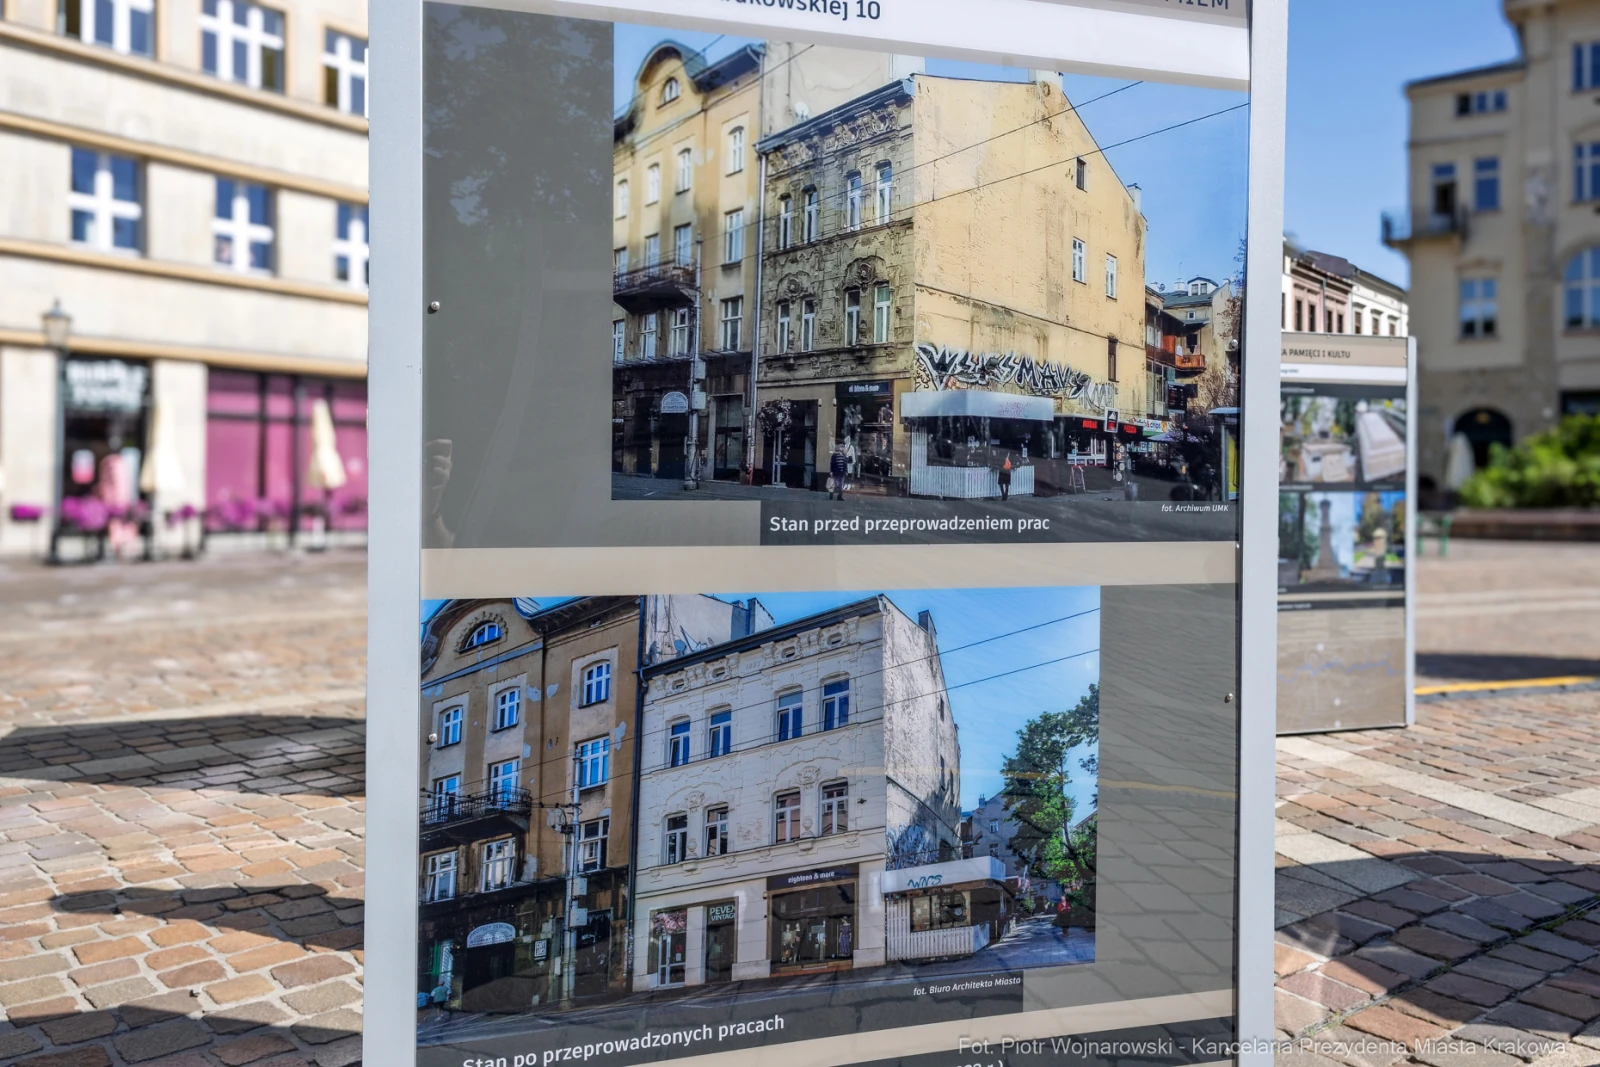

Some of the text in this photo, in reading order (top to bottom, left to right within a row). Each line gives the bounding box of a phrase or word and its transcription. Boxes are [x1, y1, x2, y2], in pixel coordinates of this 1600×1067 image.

[856, 0, 881, 20] 10
[1289, 348, 1320, 359] PAMIĘCI
[1328, 350, 1351, 359] KULTU
[1161, 503, 1229, 512] fot. Archiwum UMK
[769, 515, 1050, 534] Stan przed przeprowadzeniem prac
[820, 871, 835, 879] more
[913, 977, 1021, 996] fot. Biuro Architekta Miasta
[514, 1053, 537, 1067] po
[543, 1025, 712, 1067] przeprowadzonych
[718, 1014, 784, 1041] pracach
